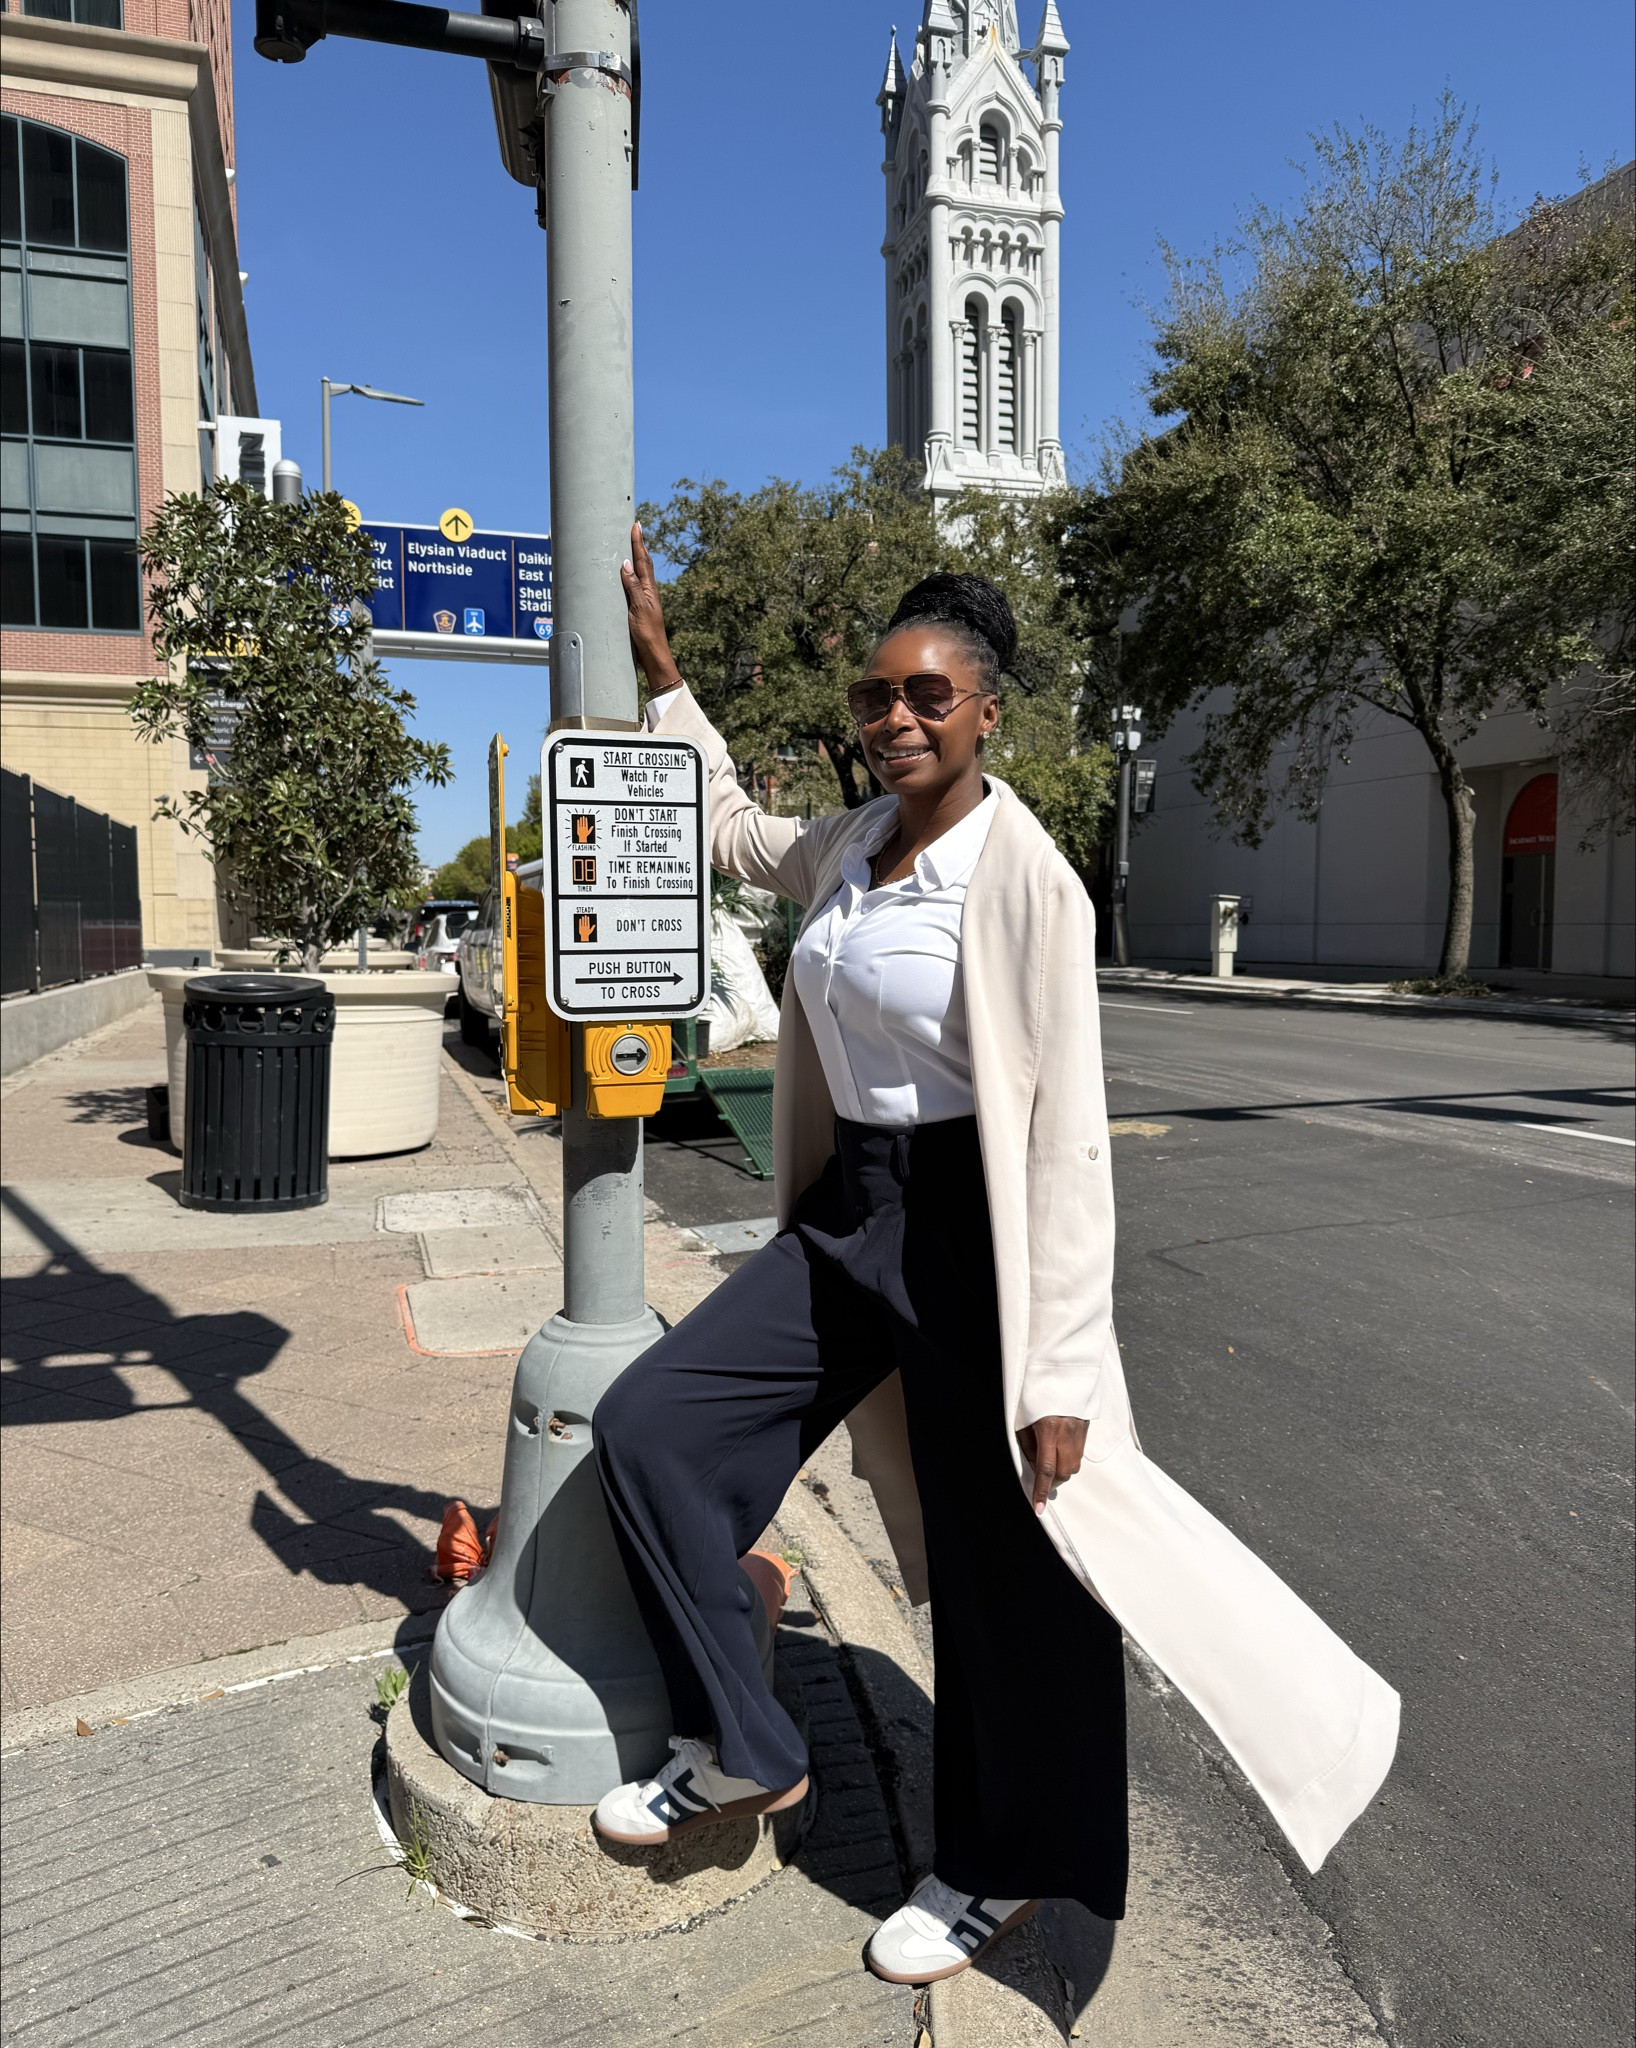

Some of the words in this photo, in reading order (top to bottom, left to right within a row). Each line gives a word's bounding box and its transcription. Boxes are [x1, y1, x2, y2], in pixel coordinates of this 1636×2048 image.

[407, 542, 454, 558] Elysian
[457, 546, 507, 561] Viaduct
[408, 561, 473, 576] Northside
[518, 568, 545, 582] East
[519, 586, 552, 600] Shell
[538, 624, 552, 636] 69
[219, 700, 246, 710] Energy
[603, 751, 632, 765] START
[638, 752, 687, 767] CROSSING
[621, 769, 648, 783] Watch
[653, 770, 668, 784] For
[627, 784, 664, 798] Vehicles
[614, 807, 644, 822] DON'T
[650, 809, 678, 822] START
[611, 825, 639, 838] Finish
[644, 825, 682, 843] Crossing
[624, 840, 632, 853] If
[635, 840, 668, 853] Started
[573, 858, 596, 882] 08
[608, 860, 632, 874] TIME
[637, 861, 691, 874] REMAINING
[577, 885, 593, 893] TIMER
[606, 876, 617, 889] To
[623, 876, 650, 889] Finish
[656, 876, 693, 893] Crossing
[576, 906, 594, 914] STEADY
[616, 919, 646, 932] DON'T
[651, 919, 683, 932] CROSS
[588, 962, 621, 975] PUSH
[626, 961, 671, 974] BUTTON
[600, 986, 616, 999] TO
[621, 985, 661, 999] CROSS
